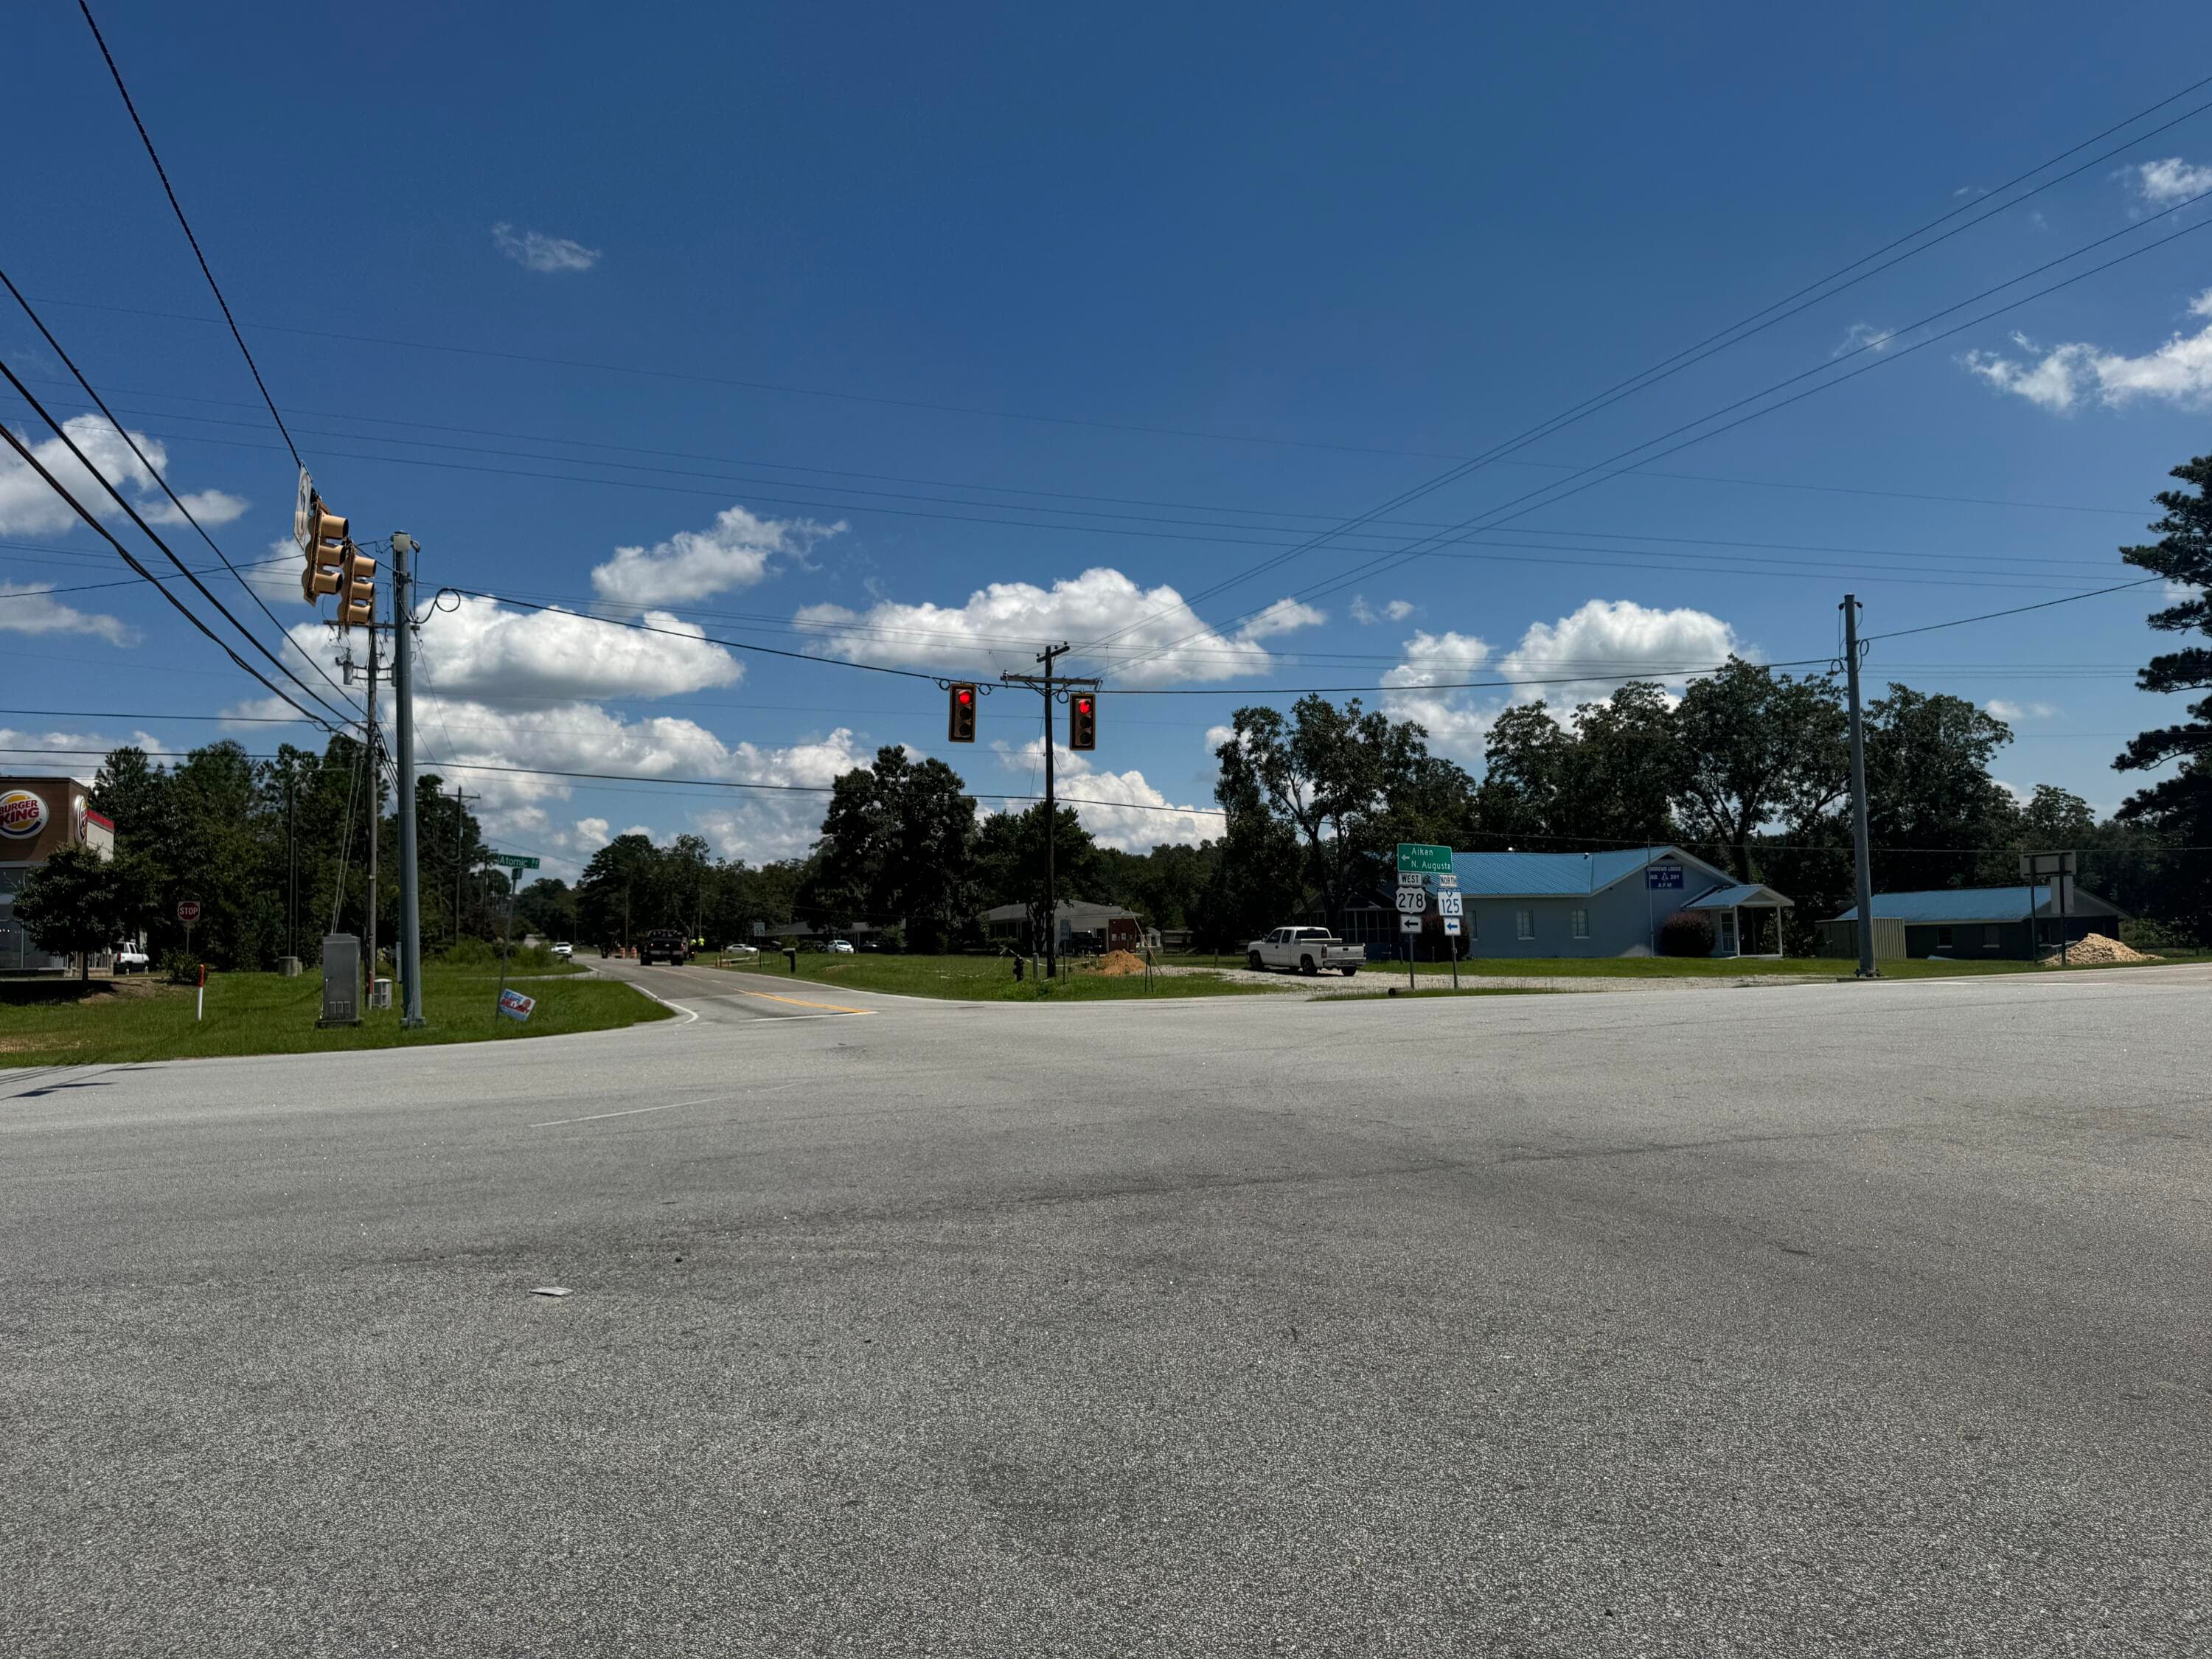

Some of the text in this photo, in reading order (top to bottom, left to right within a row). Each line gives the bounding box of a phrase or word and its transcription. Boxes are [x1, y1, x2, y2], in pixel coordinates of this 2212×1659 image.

[0, 800, 38, 814] BURGER
[0, 807, 39, 827] KING
[1411, 847, 1433, 856] Aiken
[500, 856, 528, 866] Atomic
[1422, 861, 1451, 872] Augusta
[1401, 874, 1419, 883] WEST
[1440, 876, 1457, 885] NORTH
[1398, 893, 1423, 908] 278
[179, 907, 198, 915] STOP
[1441, 899, 1460, 914] 125
